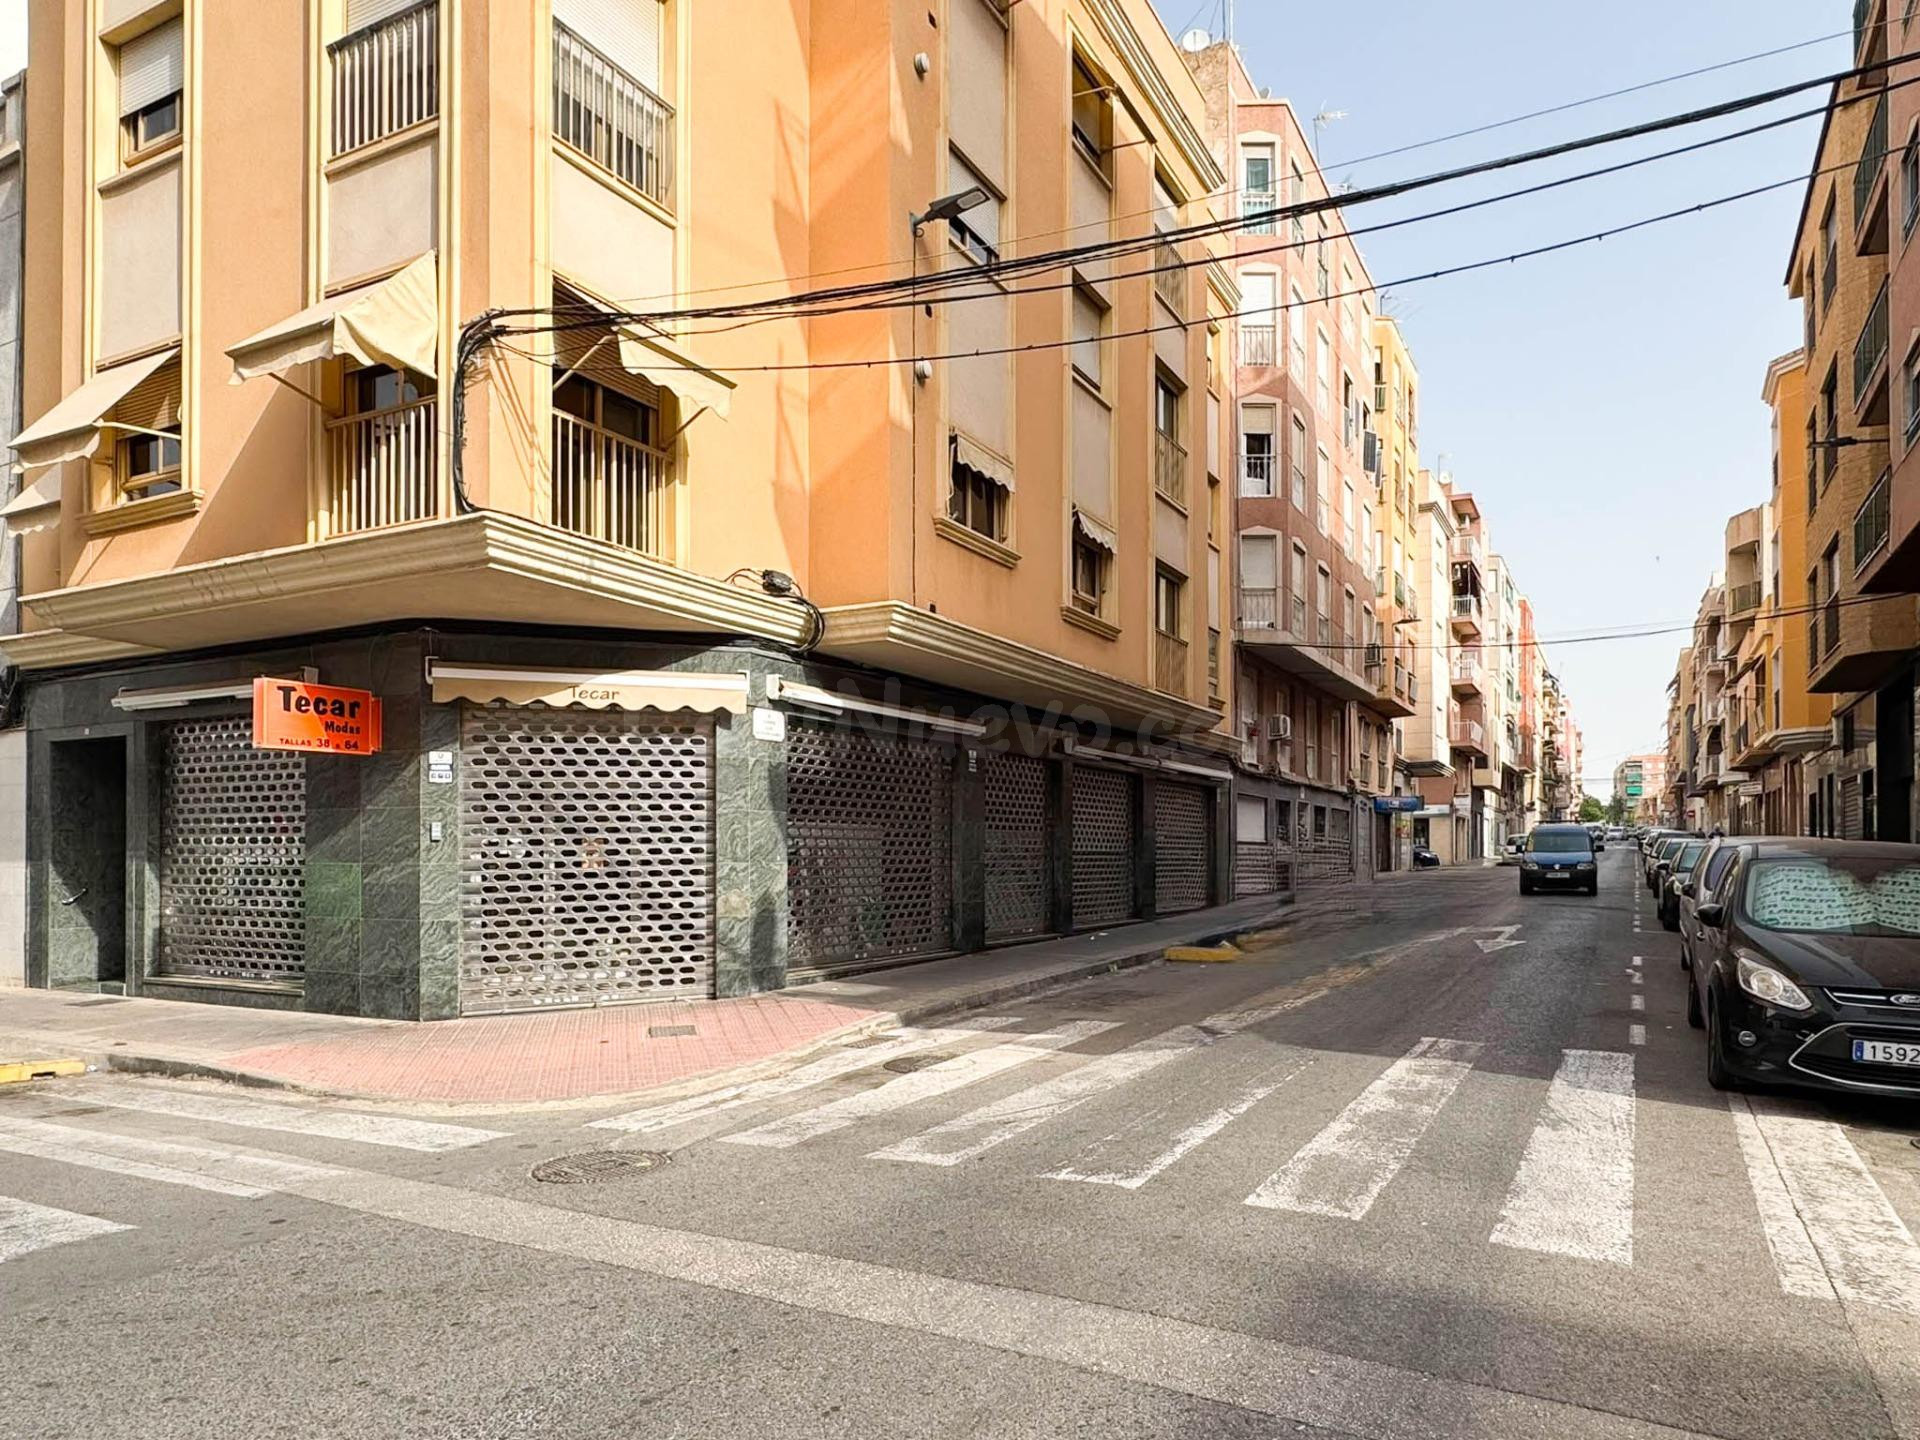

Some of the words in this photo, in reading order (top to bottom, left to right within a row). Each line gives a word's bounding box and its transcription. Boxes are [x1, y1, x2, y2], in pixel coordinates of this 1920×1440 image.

[567, 684, 620, 701] Tecar
[276, 685, 361, 719] Tecar
[324, 720, 361, 735] Modas
[279, 738, 312, 747] TALLAS
[316, 738, 330, 748] 38
[1870, 1044, 1920, 1064] 1592
